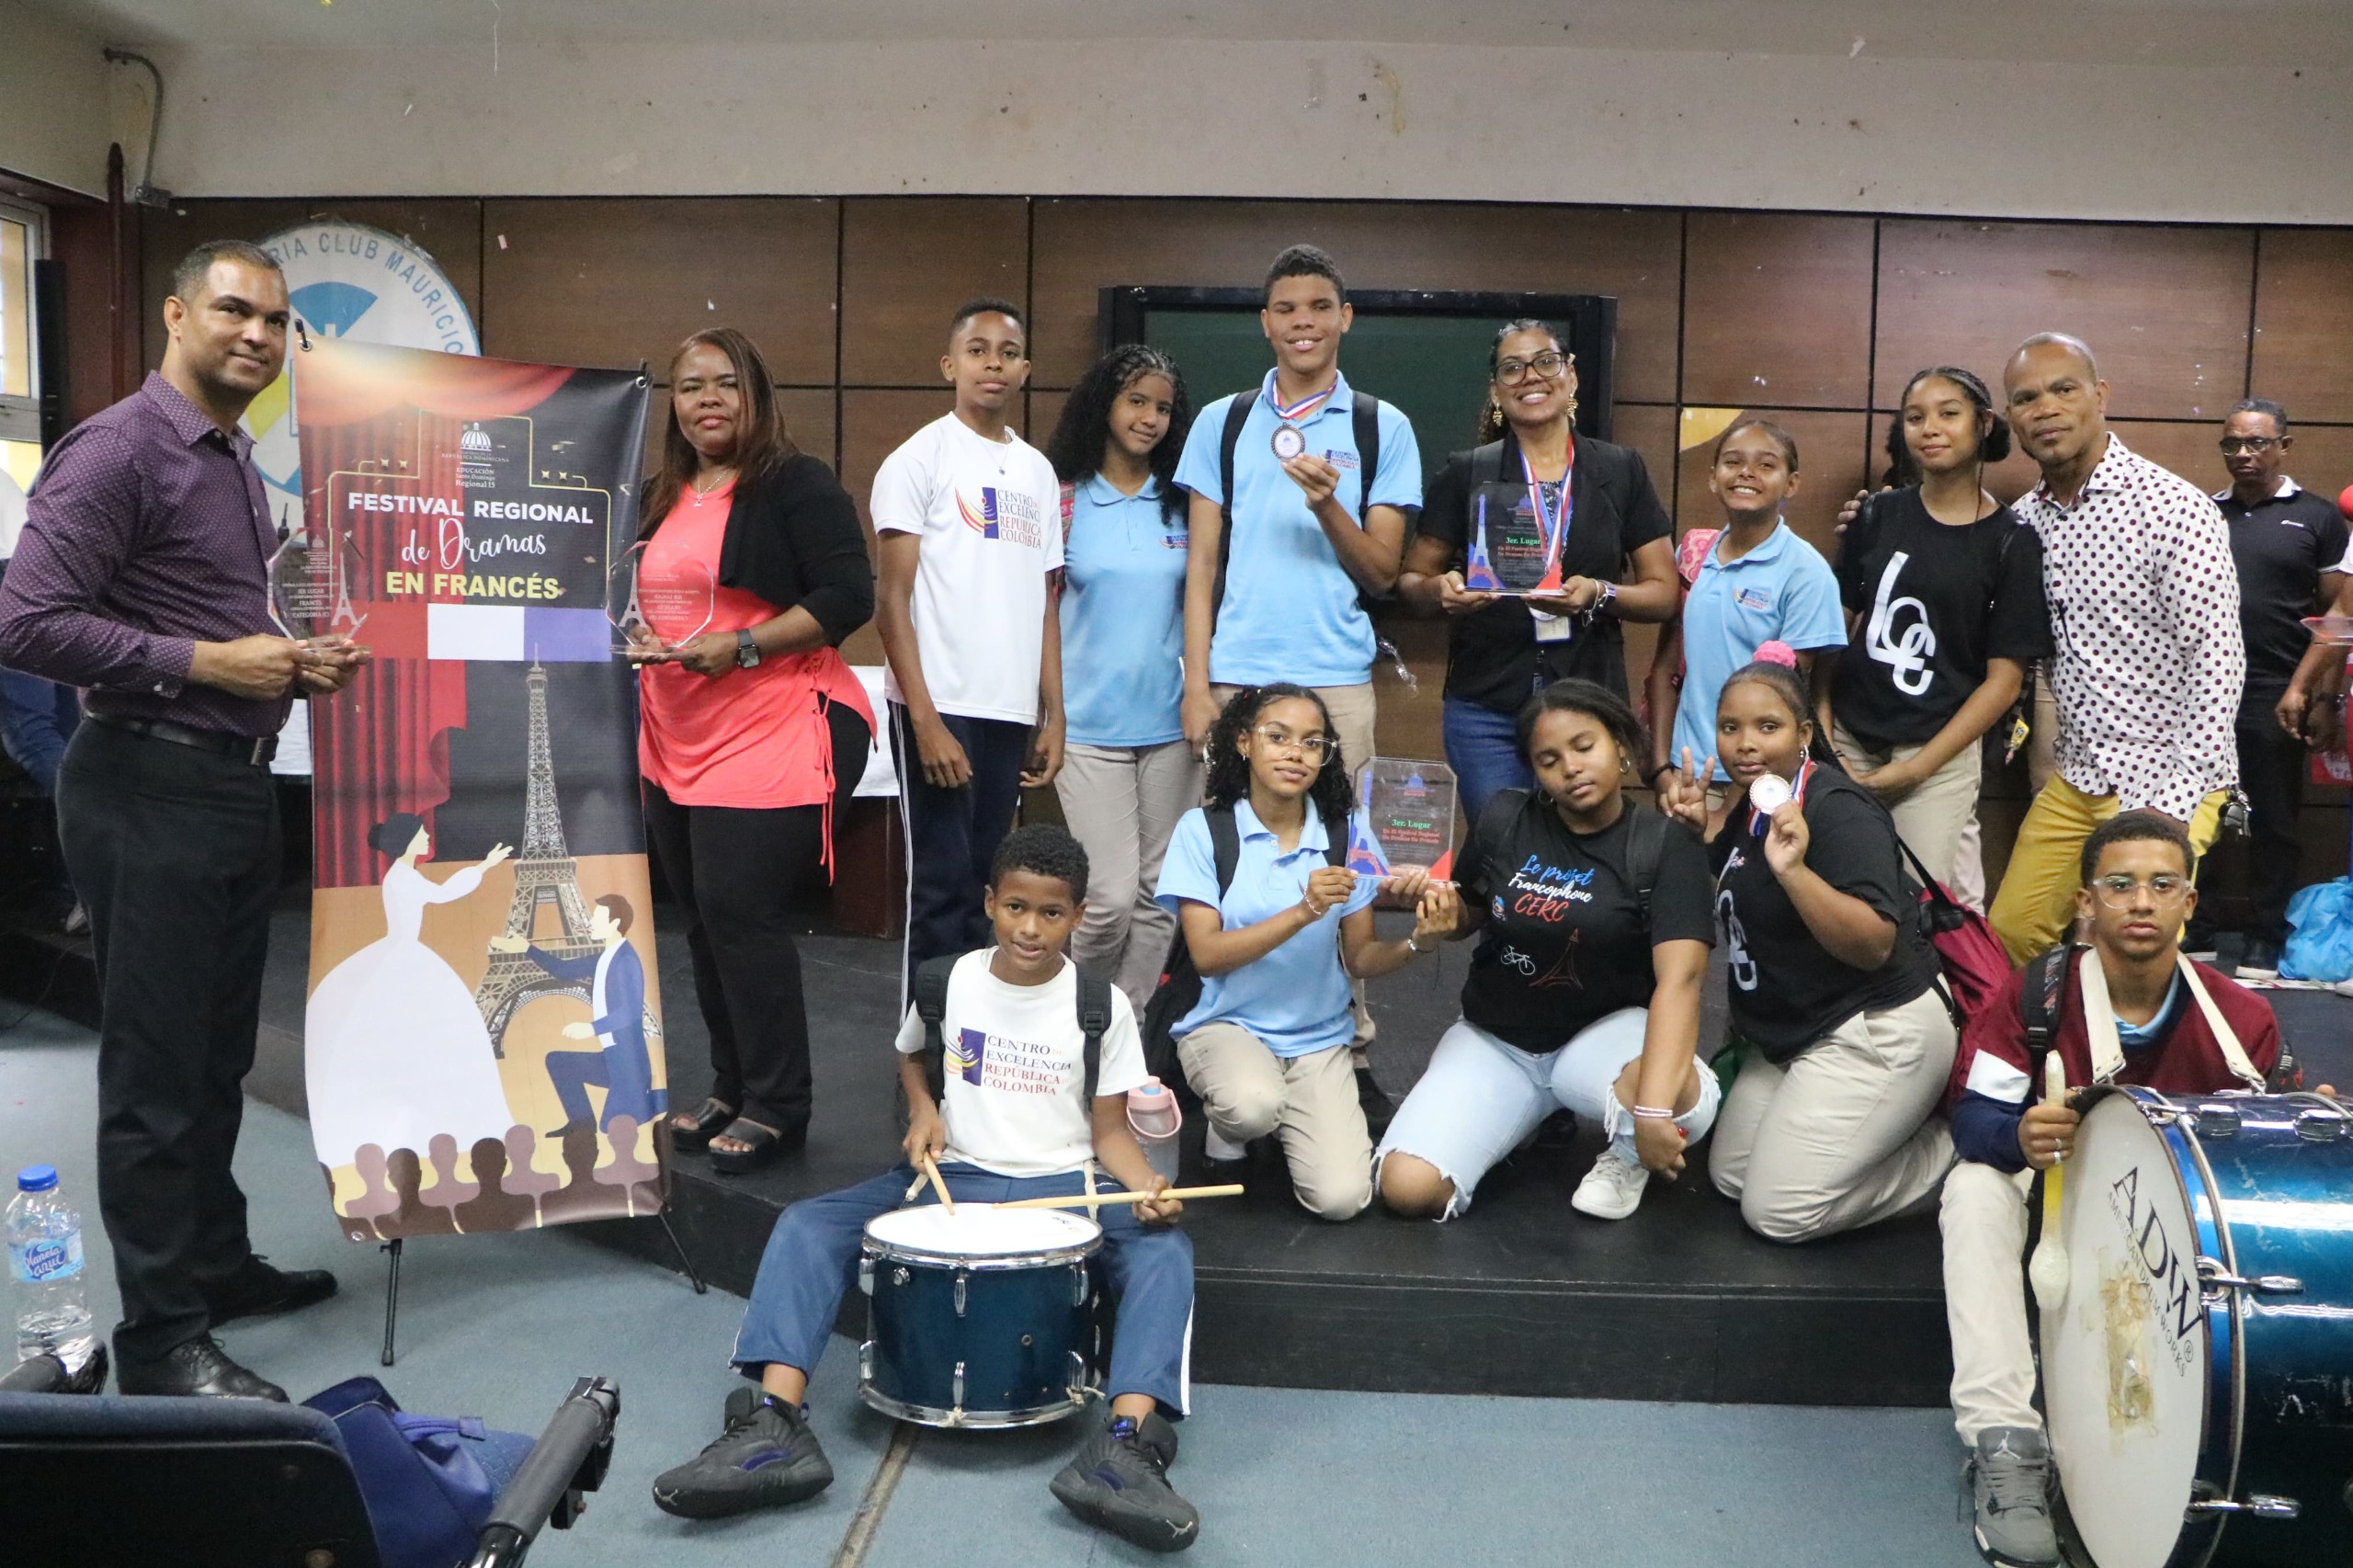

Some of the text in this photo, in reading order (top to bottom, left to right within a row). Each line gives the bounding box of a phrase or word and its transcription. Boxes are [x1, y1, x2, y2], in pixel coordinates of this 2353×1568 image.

[318, 233, 381, 260] CLUB
[384, 250, 464, 356] MAURICIO
[456, 467, 495, 475] EDUCACIÓN
[455, 479, 487, 488] Regional
[348, 492, 594, 524] FESTIVAL REGIONAL
[997, 489, 1033, 508] CENTRO
[402, 517, 547, 570] de Dramas
[1520, 538, 1540, 546] Lugar
[386, 571, 560, 599] EN FRANCÉS
[1392, 818, 1431, 829] 3er. Lugar
[1520, 854, 1596, 891] Le projet
[1507, 872, 1594, 903] Francophone
[1514, 892, 1570, 922] CERC
[987, 1035, 1051, 1055] CENTRO
[986, 1050, 1072, 1072] EXCELENCIA
[983, 1076, 1057, 1096] COLOMBIA
[33, 1255, 65, 1278] azul
[2160, 1314, 2186, 1377] WORKS
